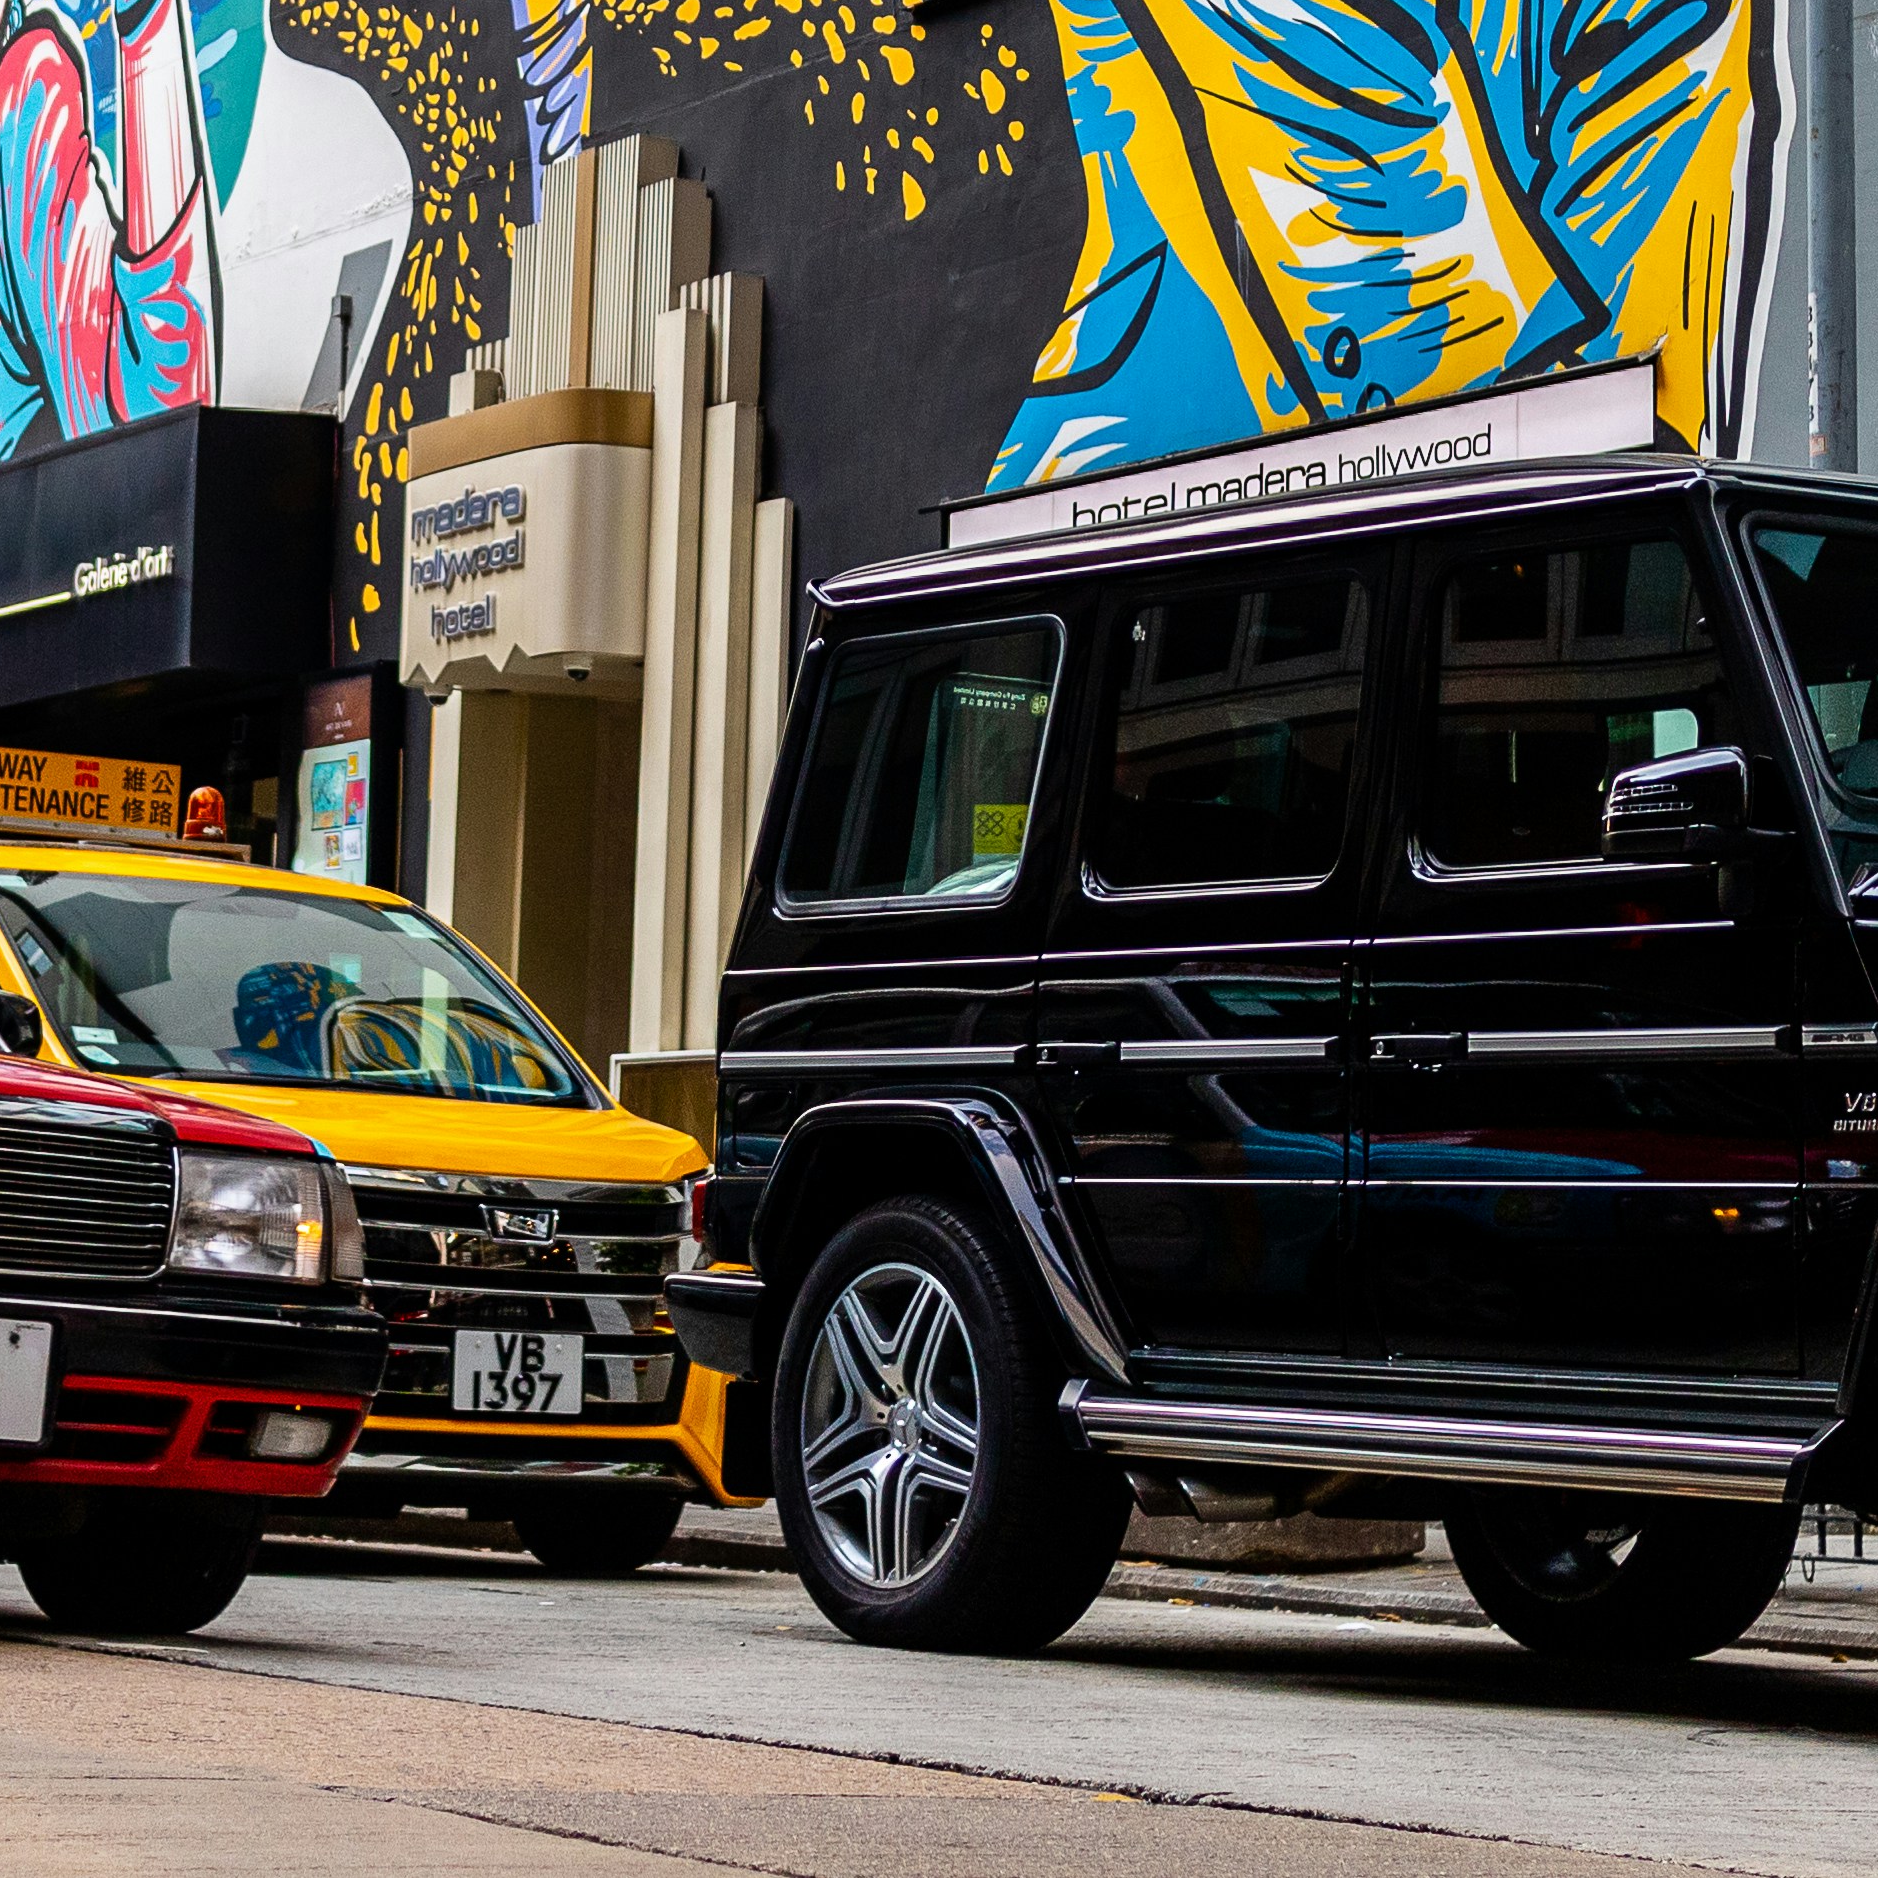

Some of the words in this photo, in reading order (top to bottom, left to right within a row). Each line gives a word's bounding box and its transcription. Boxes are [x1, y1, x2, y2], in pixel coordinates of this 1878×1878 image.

[1072, 482, 1177, 528] hotel
[1186, 461, 1327, 509] madera
[1338, 423, 1492, 483] hollywood
[412, 485, 524, 543] madera
[74, 552, 128, 597] Galerie
[411, 528, 524, 588] hollywood
[431, 592, 495, 638] hotel
[494, 1333, 546, 1373] VB
[472, 1371, 564, 1412] 1397
